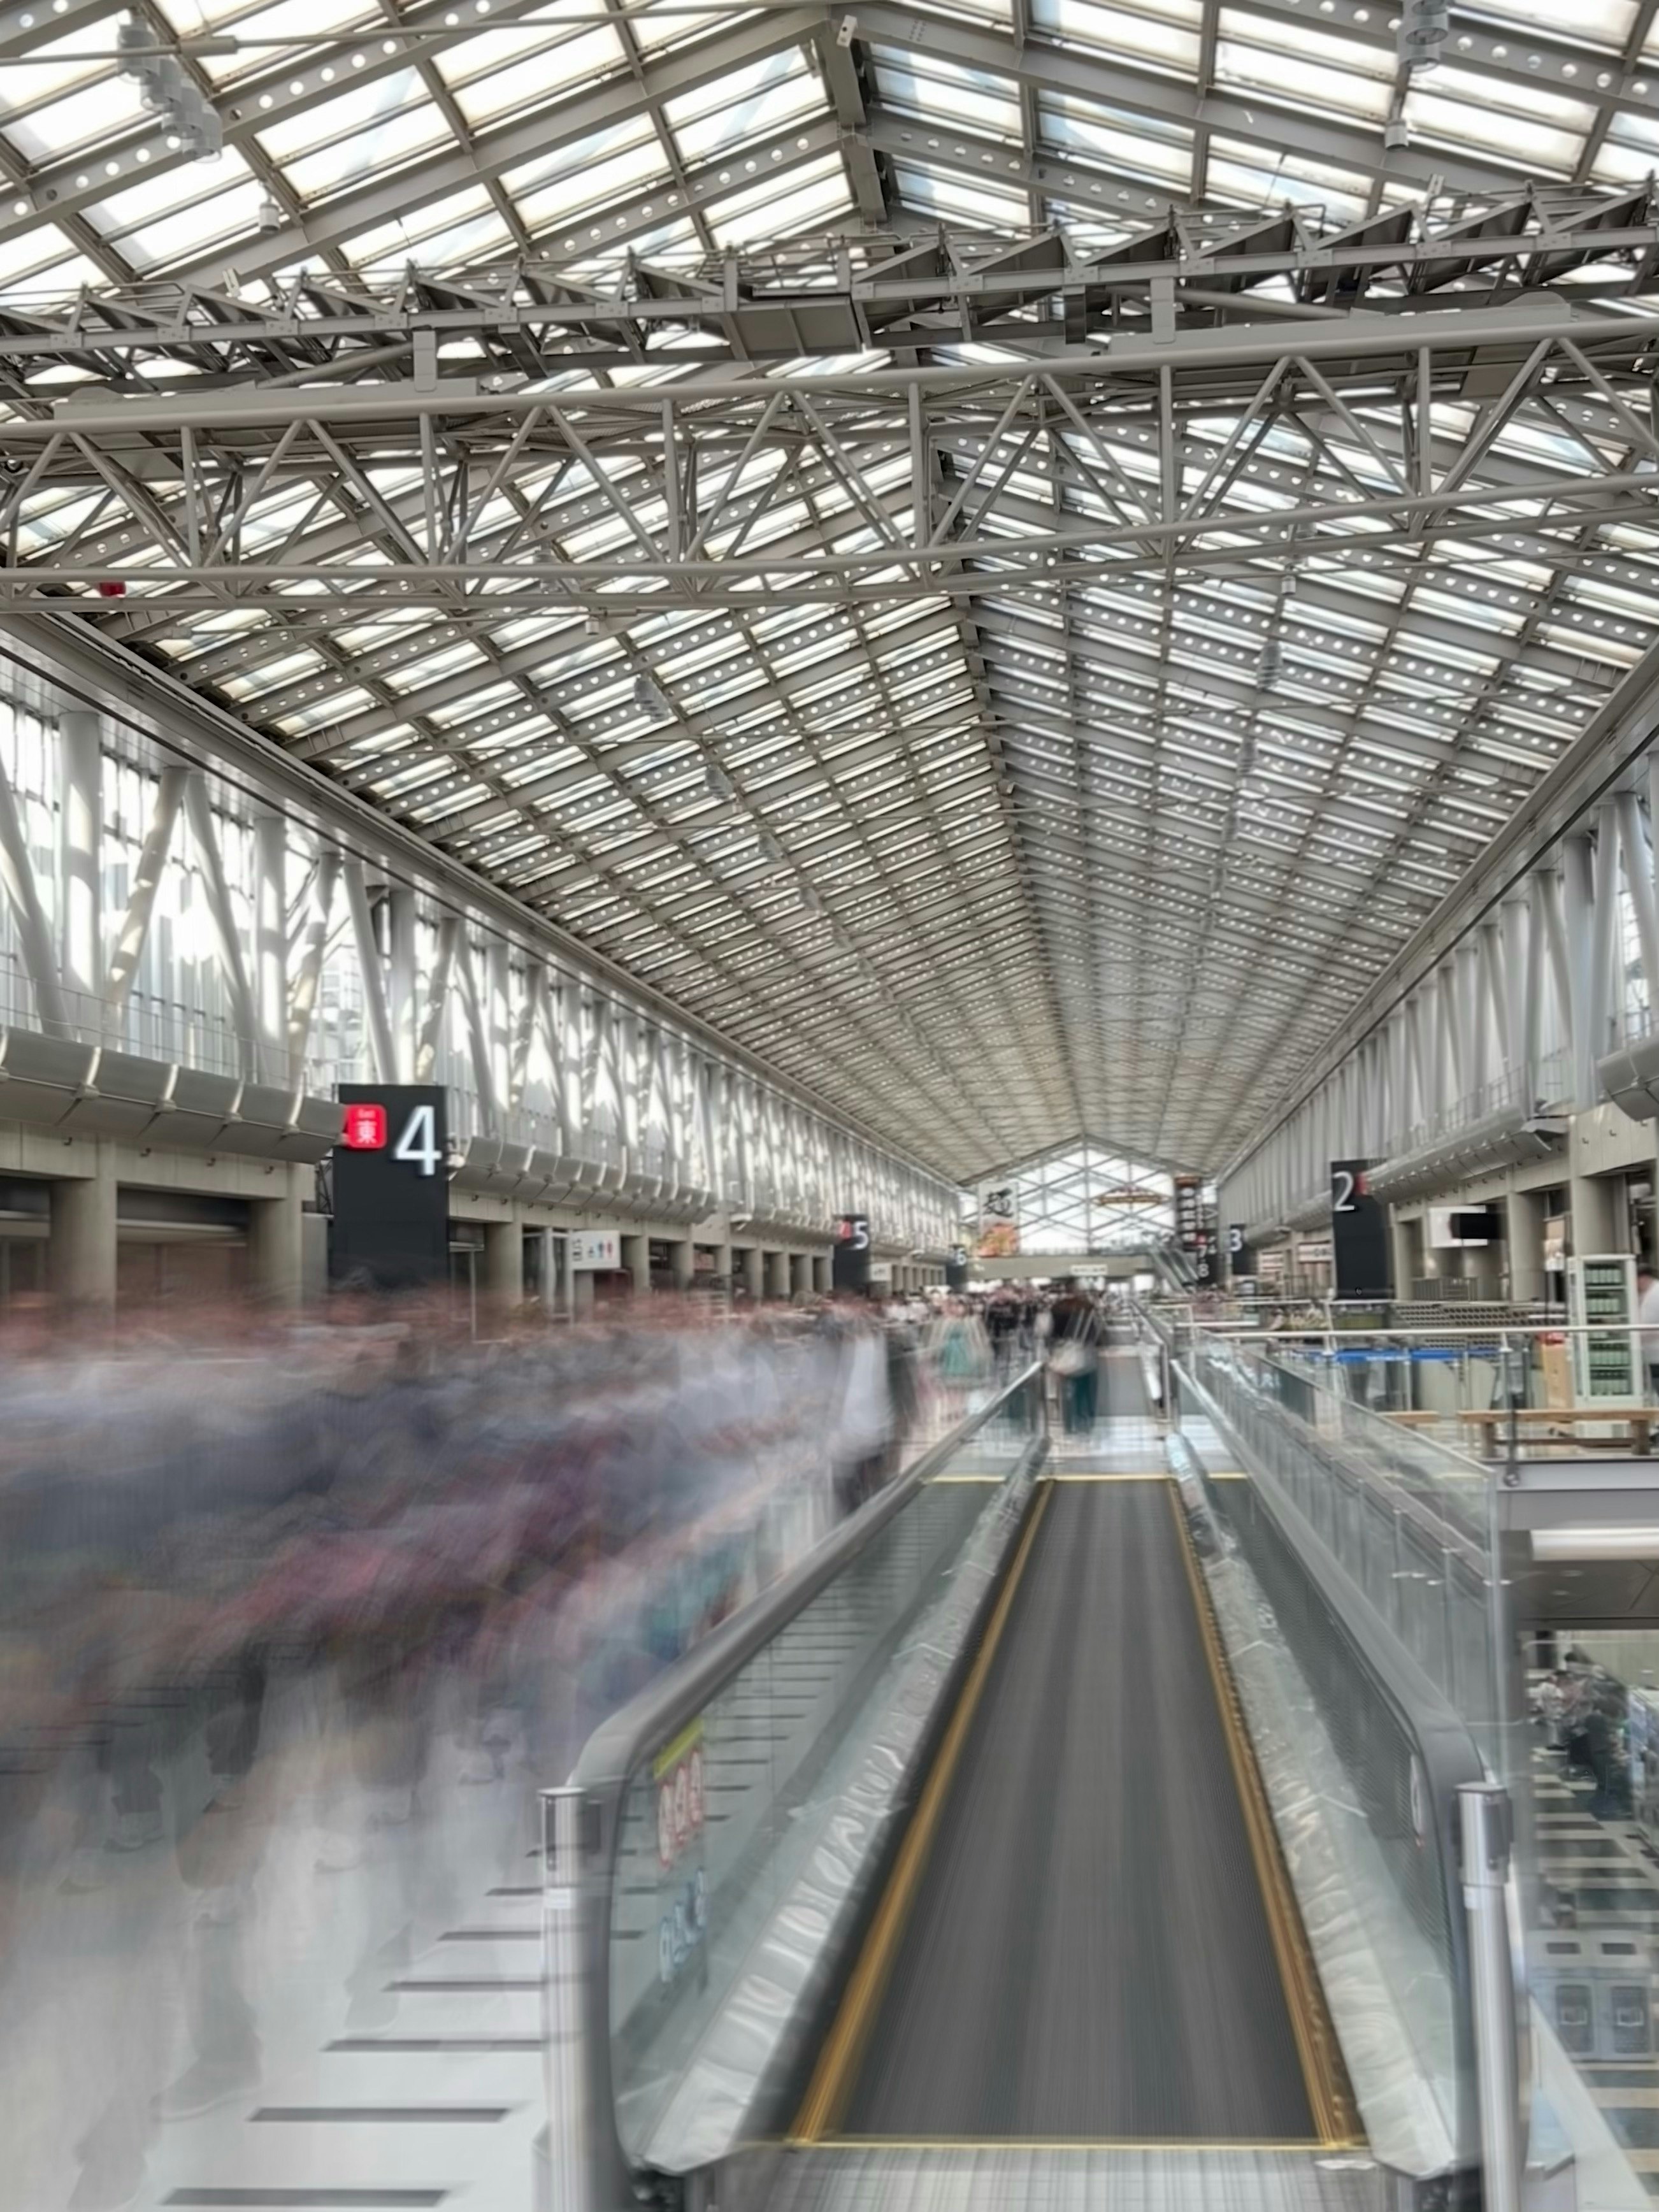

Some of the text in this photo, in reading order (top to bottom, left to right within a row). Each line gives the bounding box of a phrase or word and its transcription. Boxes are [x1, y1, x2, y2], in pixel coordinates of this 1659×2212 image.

[357, 1120, 377, 1144] 東
[394, 1105, 443, 1175] 4
[1333, 1171, 1355, 1211] 2
[853, 1221, 869, 1249] 5
[1230, 1229, 1242, 1252] 3
[957, 1247, 967, 1265] 6
[1198, 1244, 1207, 1258] 7
[1198, 1263, 1209, 1277] 8
